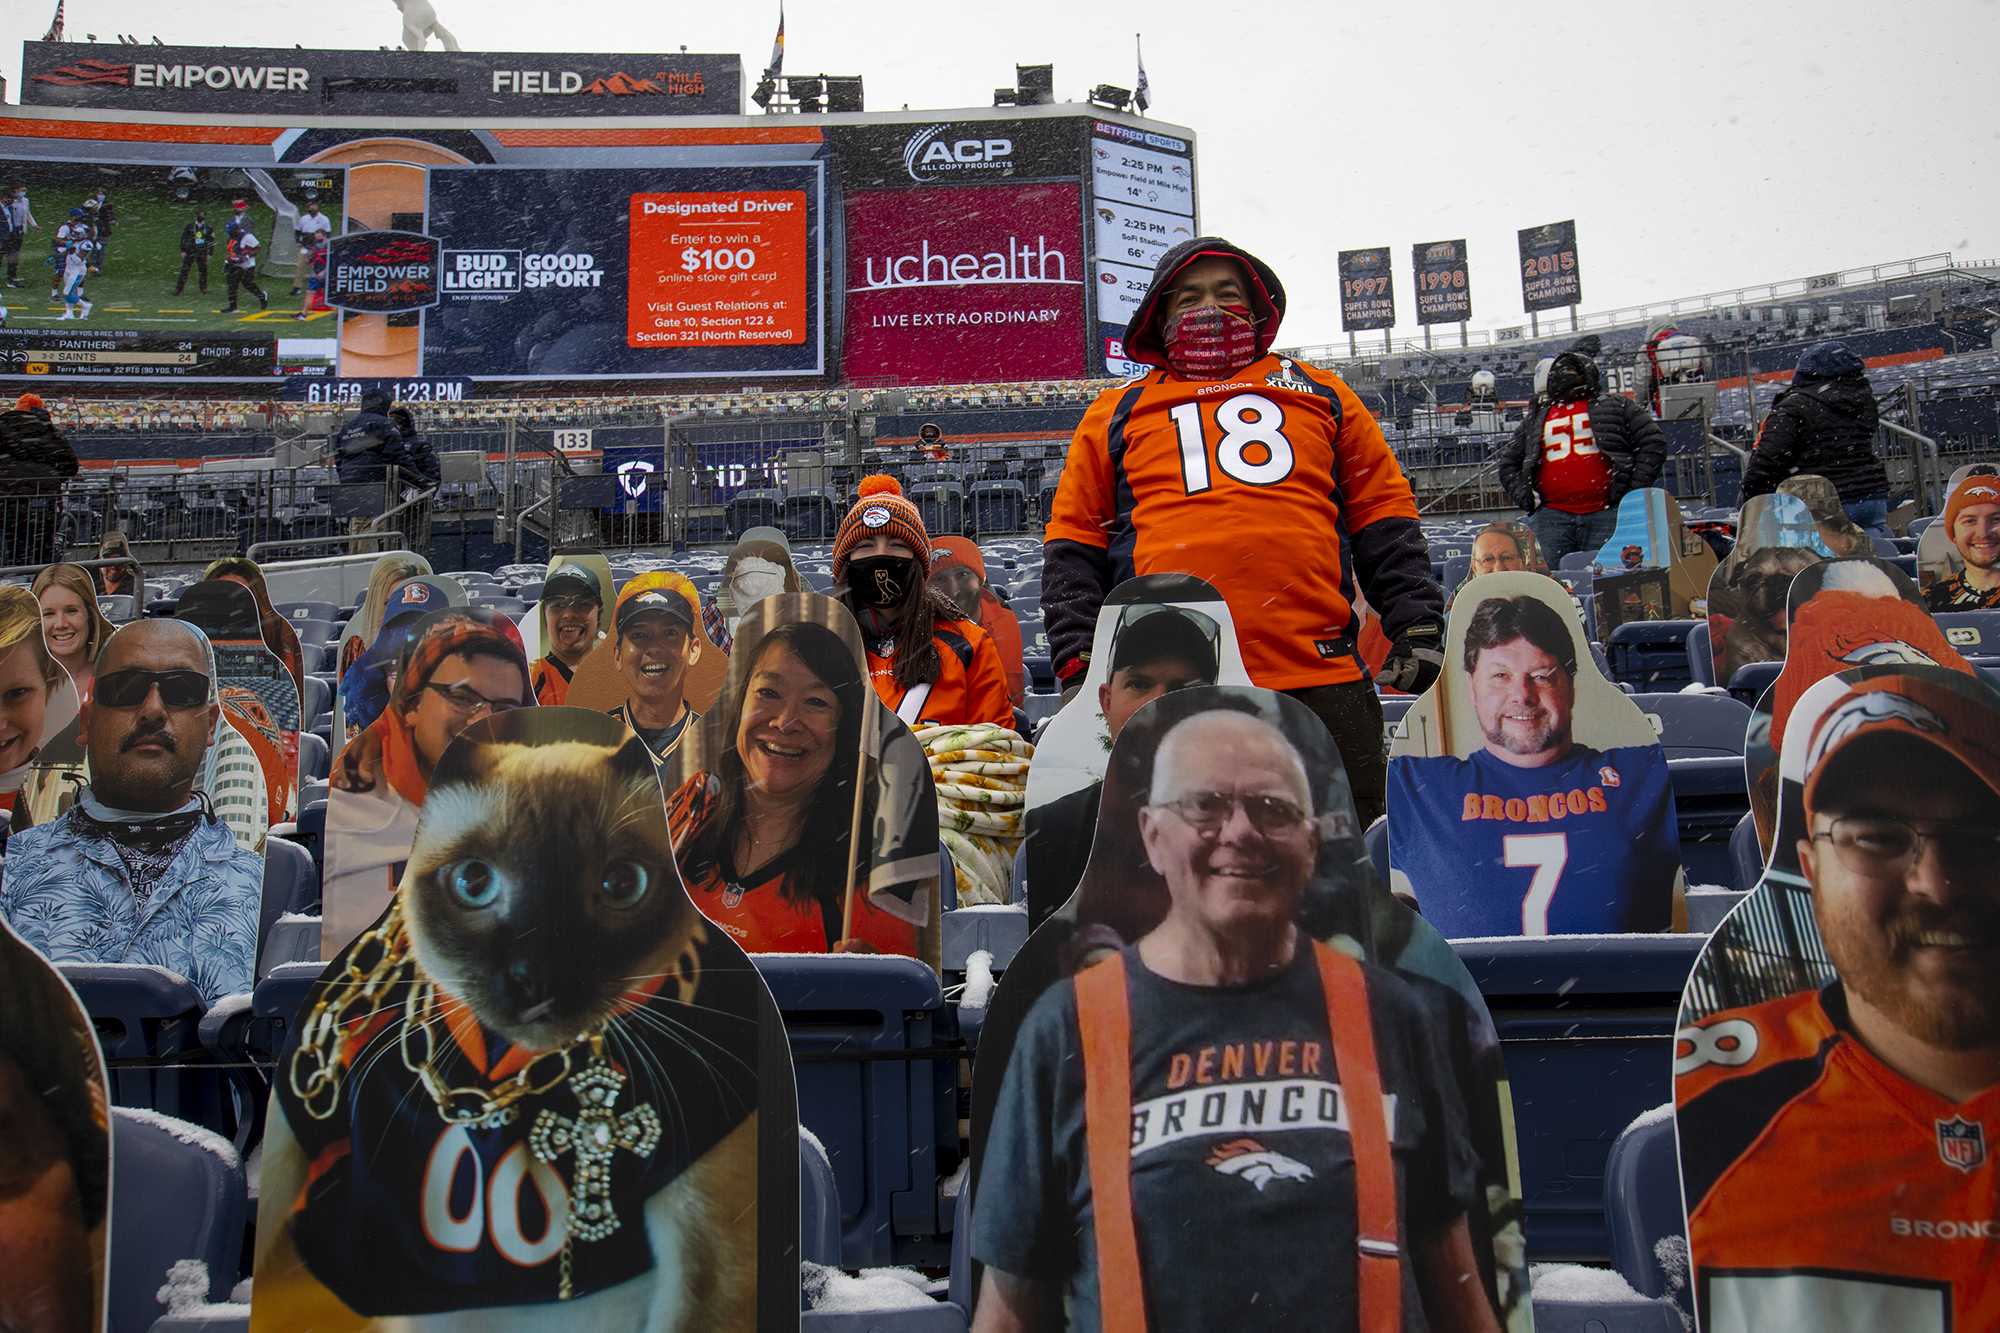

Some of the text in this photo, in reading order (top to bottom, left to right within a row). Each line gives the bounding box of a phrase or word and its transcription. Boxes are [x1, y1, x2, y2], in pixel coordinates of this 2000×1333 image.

[134, 64, 310, 91] EMPOWER
[493, 70, 583, 95] FIELD
[655, 72, 703, 84] AT MILE
[669, 84, 705, 95] HIGH
[1096, 122, 1182, 150] BETFRED SPORTS
[921, 139, 1012, 163] ACP
[965, 161, 1013, 169] PRODUCTS
[1121, 157, 1163, 174] 2:25 PM
[1130, 174, 1147, 184] Field
[1157, 180, 1170, 189] Mile
[1172, 183, 1188, 193] High
[643, 200, 794, 216] Designated Driver
[1124, 218, 1166, 235] 2:25 PM
[671, 233, 761, 245] Enter to win a
[1122, 233, 1169, 248] SoFi Stadium
[456, 254, 507, 271] BUD
[524, 253, 594, 270] GOOD
[681, 247, 756, 273] $100
[866, 235, 1065, 287] uchealth
[1525, 252, 1574, 277] 2015
[337, 266, 429, 279] EMPOWER
[445, 271, 516, 288] LIGHT
[523, 270, 604, 288] SPORT
[658, 271, 777, 284] online store gift card
[1420, 270, 1465, 290] 1998
[336, 280, 388, 293] FIELD
[1127, 280, 1148, 292] 2:25
[1344, 277, 1388, 297] 1997
[1525, 275, 1577, 292] SUPER BOWL
[1811, 276, 1835, 289] 236
[1119, 294, 1141, 304] Gillett
[1420, 291, 1468, 305] SUPER BOWL
[1528, 285, 1576, 301] CHAMPIONS
[647, 300, 788, 312] Visit Guest Relations at:
[1344, 299, 1392, 311] SUPER BOWL
[1422, 301, 1468, 313] CHAMPIONS
[655, 316, 775, 328] Gate 10, Section 122 &
[873, 308, 1061, 328] LIVE EXTRAORDINARY
[1346, 308, 1392, 320] CHAMPIONS
[636, 329, 793, 342] Section 321 (North Reserved)
[1500, 329, 1519, 341] 235
[59, 340, 116, 349] PANTHERS
[179, 342, 192, 350] 24
[201, 347, 215, 356] 4TH
[216, 347, 230, 357] QTR
[58, 353, 97, 361] SAINTS
[178, 354, 191, 362] 24
[56, 366, 76, 374] Terry
[393, 382, 430, 402] 1:23
[436, 382, 463, 401] PM
[1265, 378, 1313, 394] XLVIII
[558, 433, 588, 447] 133
[1168, 393, 1295, 496] 18
[1544, 413, 1600, 462] 55
[1462, 786, 1608, 823] BRONCOS
[1503, 832, 1569, 935] 7
[1167, 1041, 1321, 1089] DENVER
[1131, 1086, 1338, 1147] BRONCO
[1945, 1138, 1977, 1161] NFL
[421, 1121, 573, 1267] 00
